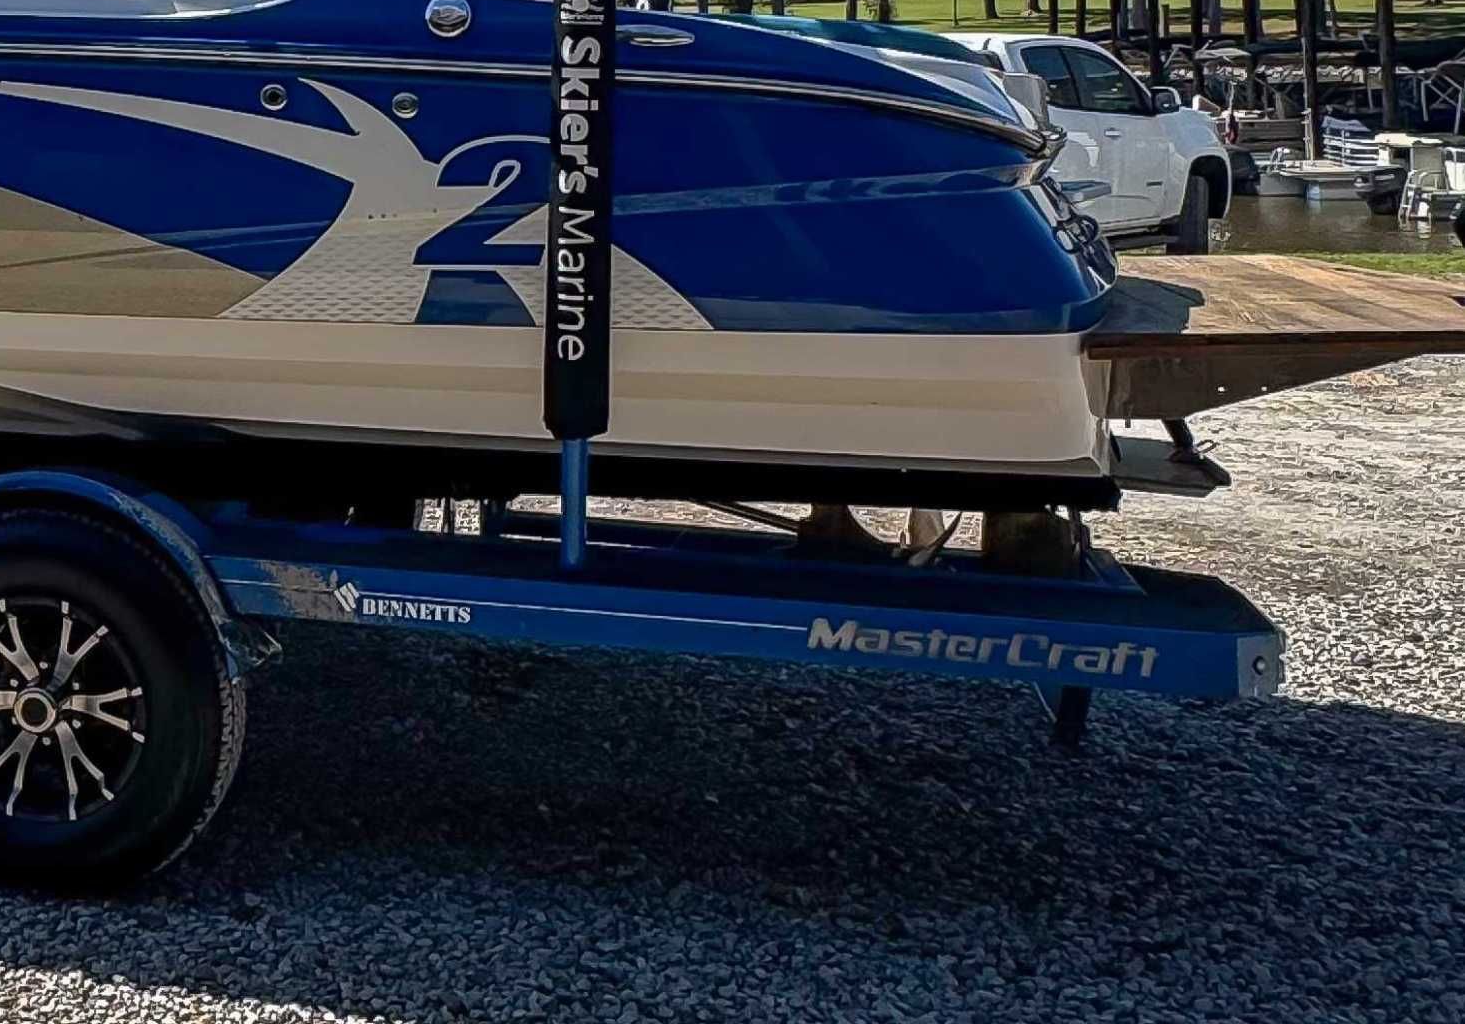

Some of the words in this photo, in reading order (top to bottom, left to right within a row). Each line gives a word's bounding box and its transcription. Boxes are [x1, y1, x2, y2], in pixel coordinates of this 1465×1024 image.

[559, 35, 601, 194] Skier's
[558, 205, 595, 361] Marine
[362, 598, 471, 623] BENNETTS
[807, 617, 1159, 676] MasterCraft
